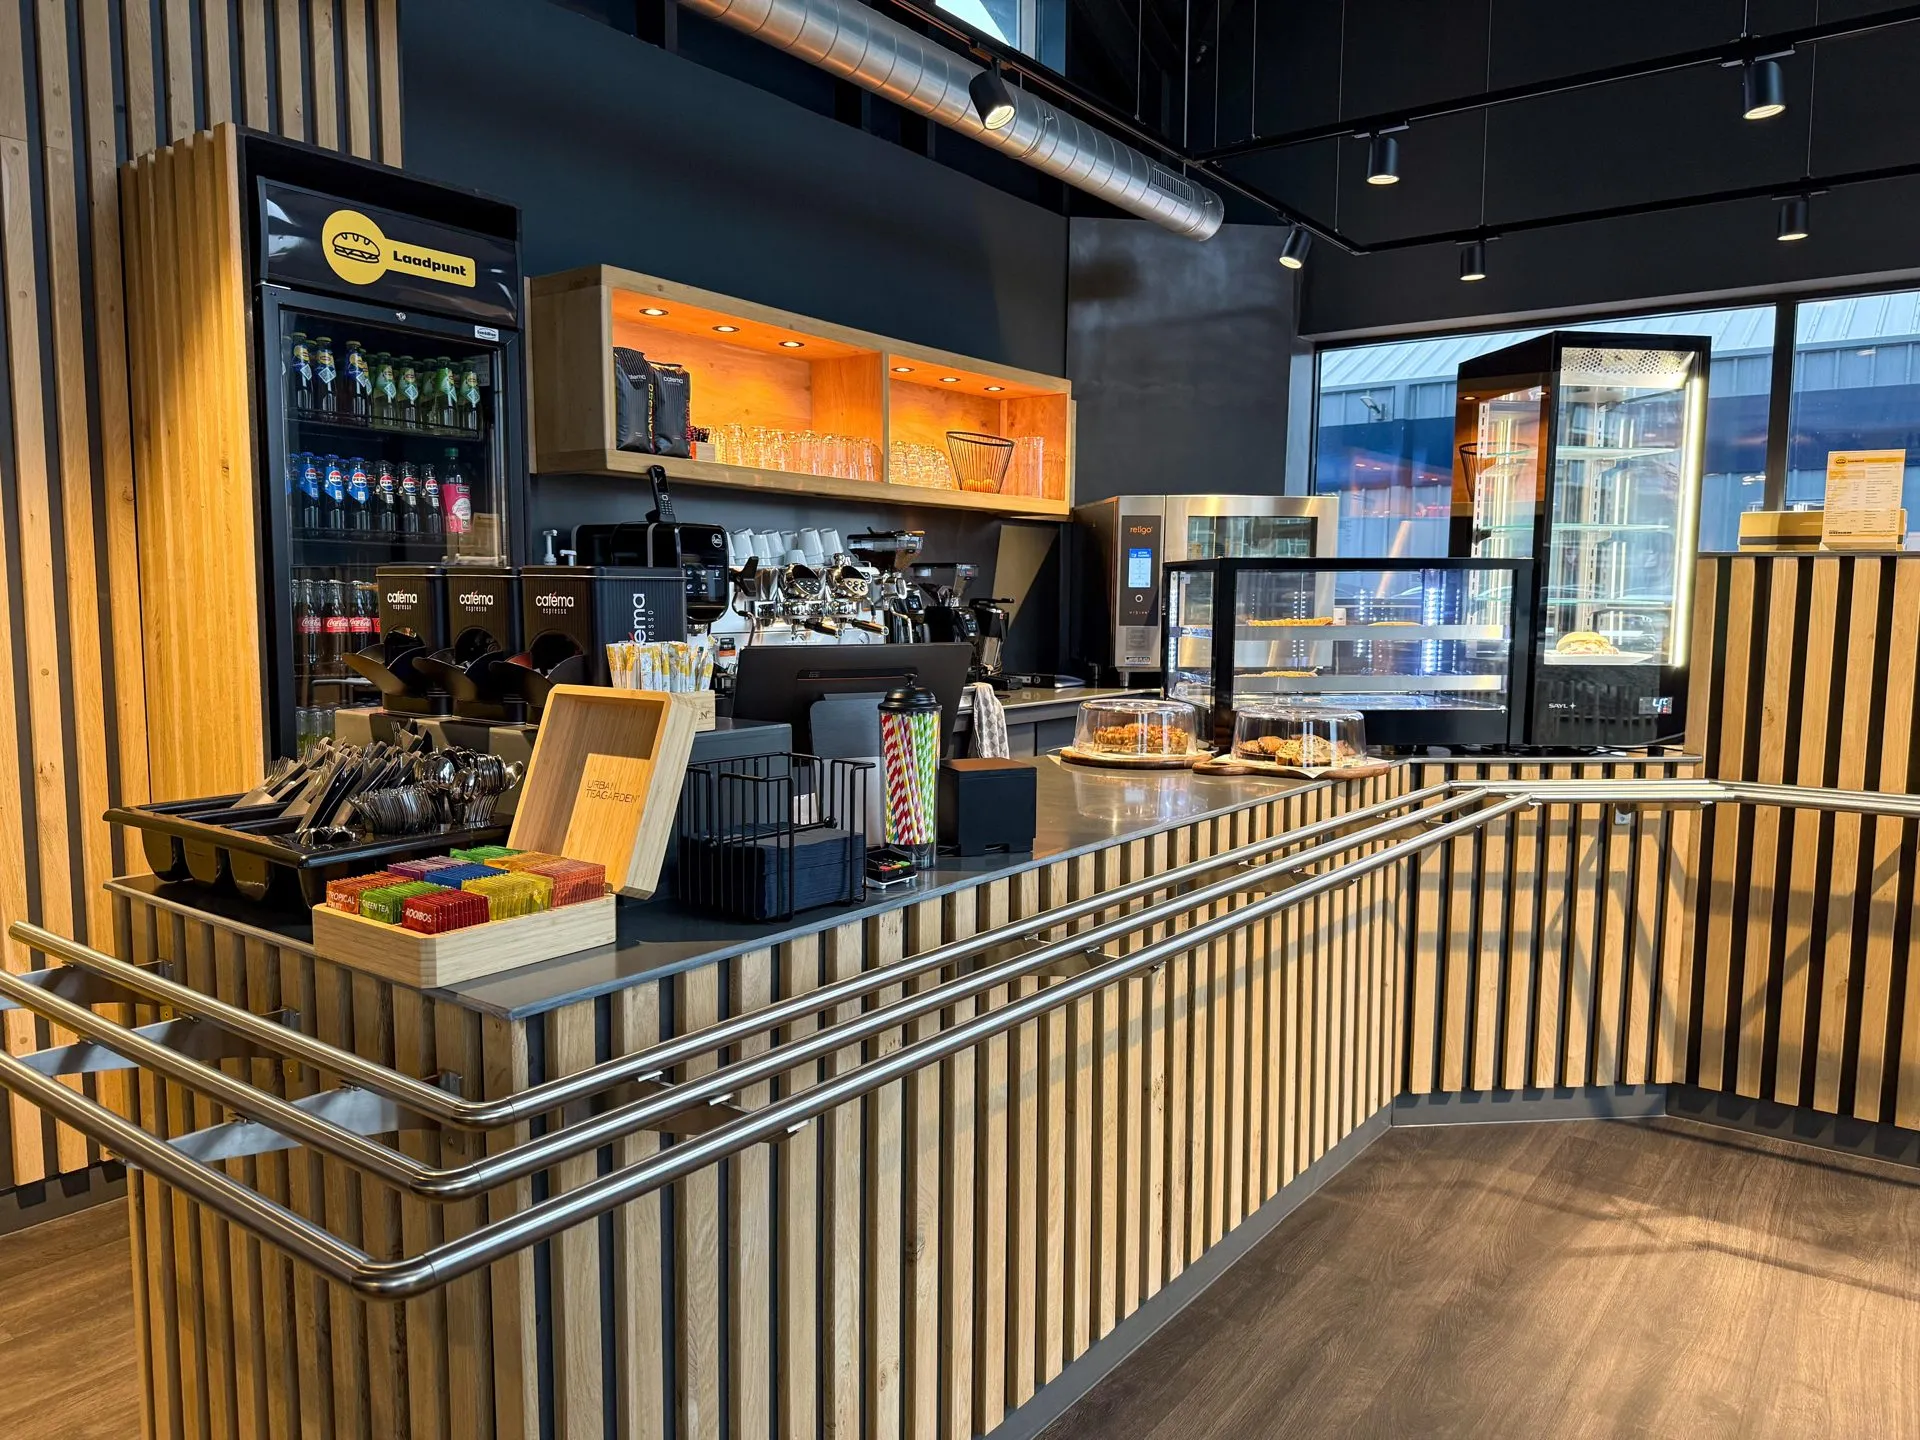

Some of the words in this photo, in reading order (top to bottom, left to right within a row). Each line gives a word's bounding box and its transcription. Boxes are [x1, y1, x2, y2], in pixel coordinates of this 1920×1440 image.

[393, 250, 467, 276] Laadpunt
[387, 589, 418, 604] caféma
[459, 590, 494, 605] caféma
[535, 591, 575, 607] caféma
[628, 593, 647, 643] éma
[647, 610, 655, 641] resso
[587, 780, 618, 791] URBAN
[328, 891, 355, 905] TROPICAL
[362, 899, 378, 910] GREEN
[378, 904, 390, 914] TEA
[405, 907, 432, 923] ROOIBOS
